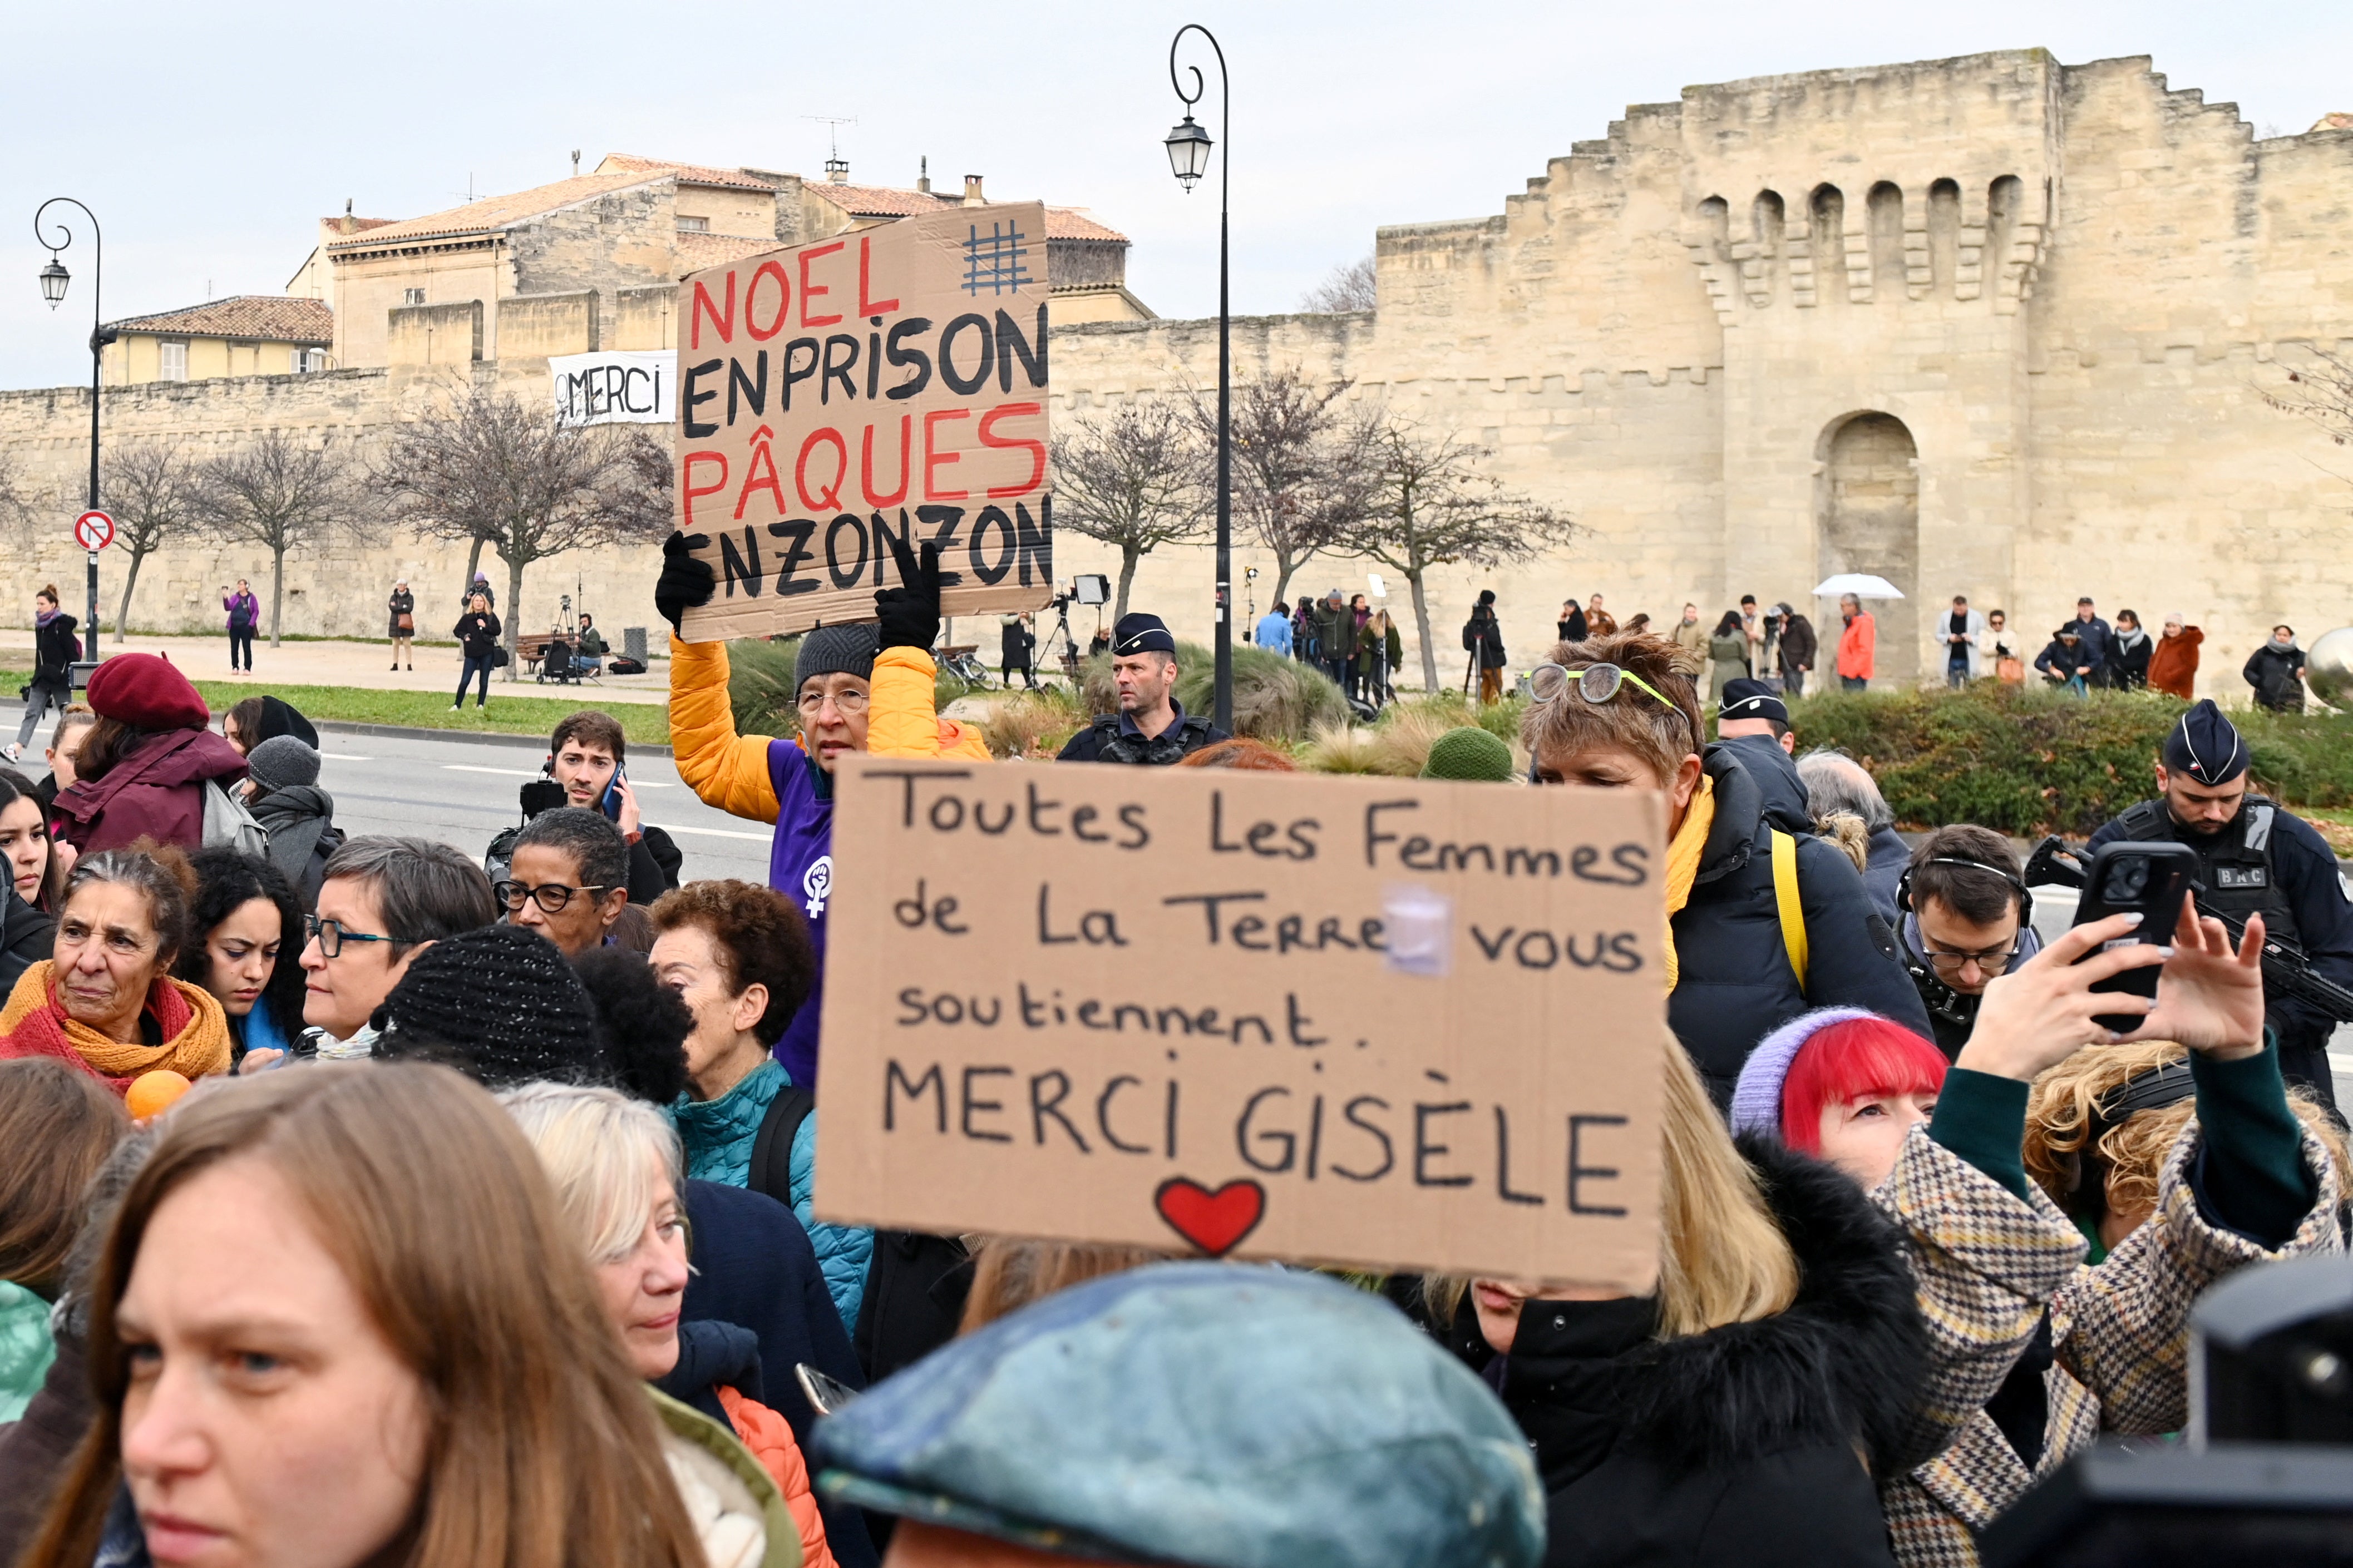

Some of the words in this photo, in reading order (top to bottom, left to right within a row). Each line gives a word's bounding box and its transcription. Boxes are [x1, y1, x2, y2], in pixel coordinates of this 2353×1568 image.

[691, 236, 899, 350] NOEL
[684, 402, 1047, 526] PÂQUES
[861, 769, 1151, 852] Toutes
[1211, 790, 1321, 860] Les
[1365, 799, 1651, 887] Femmes
[894, 879, 970, 935] de
[1038, 883, 1129, 947] La
[1472, 921, 1644, 973] vous
